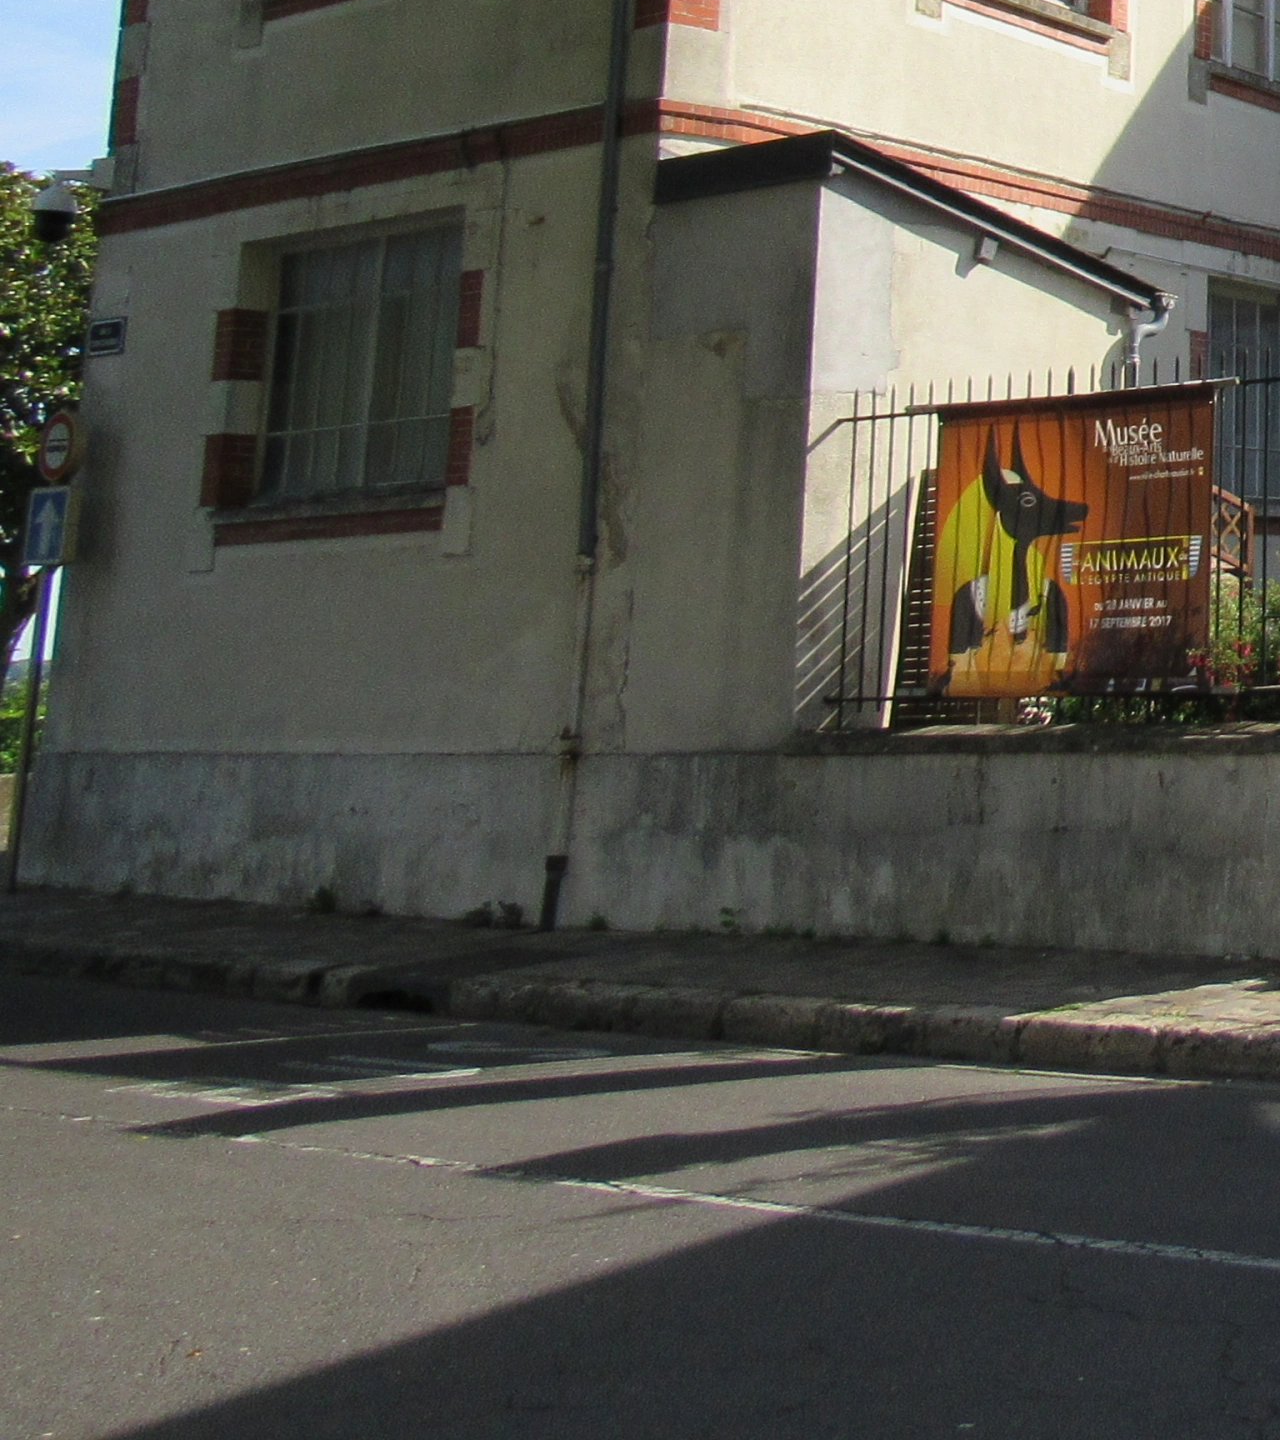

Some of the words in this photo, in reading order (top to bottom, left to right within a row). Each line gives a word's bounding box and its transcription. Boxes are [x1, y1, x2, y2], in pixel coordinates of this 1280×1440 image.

[1094, 417, 1163, 447] Musée
[1081, 546, 1179, 572] ANIMAUX
[1133, 570, 1181, 583] ANTIQUE
[1118, 597, 1155, 610] JANVIER
[1100, 616, 1147, 629] SEPTEMBRE
[1148, 615, 1173, 628] 2017
